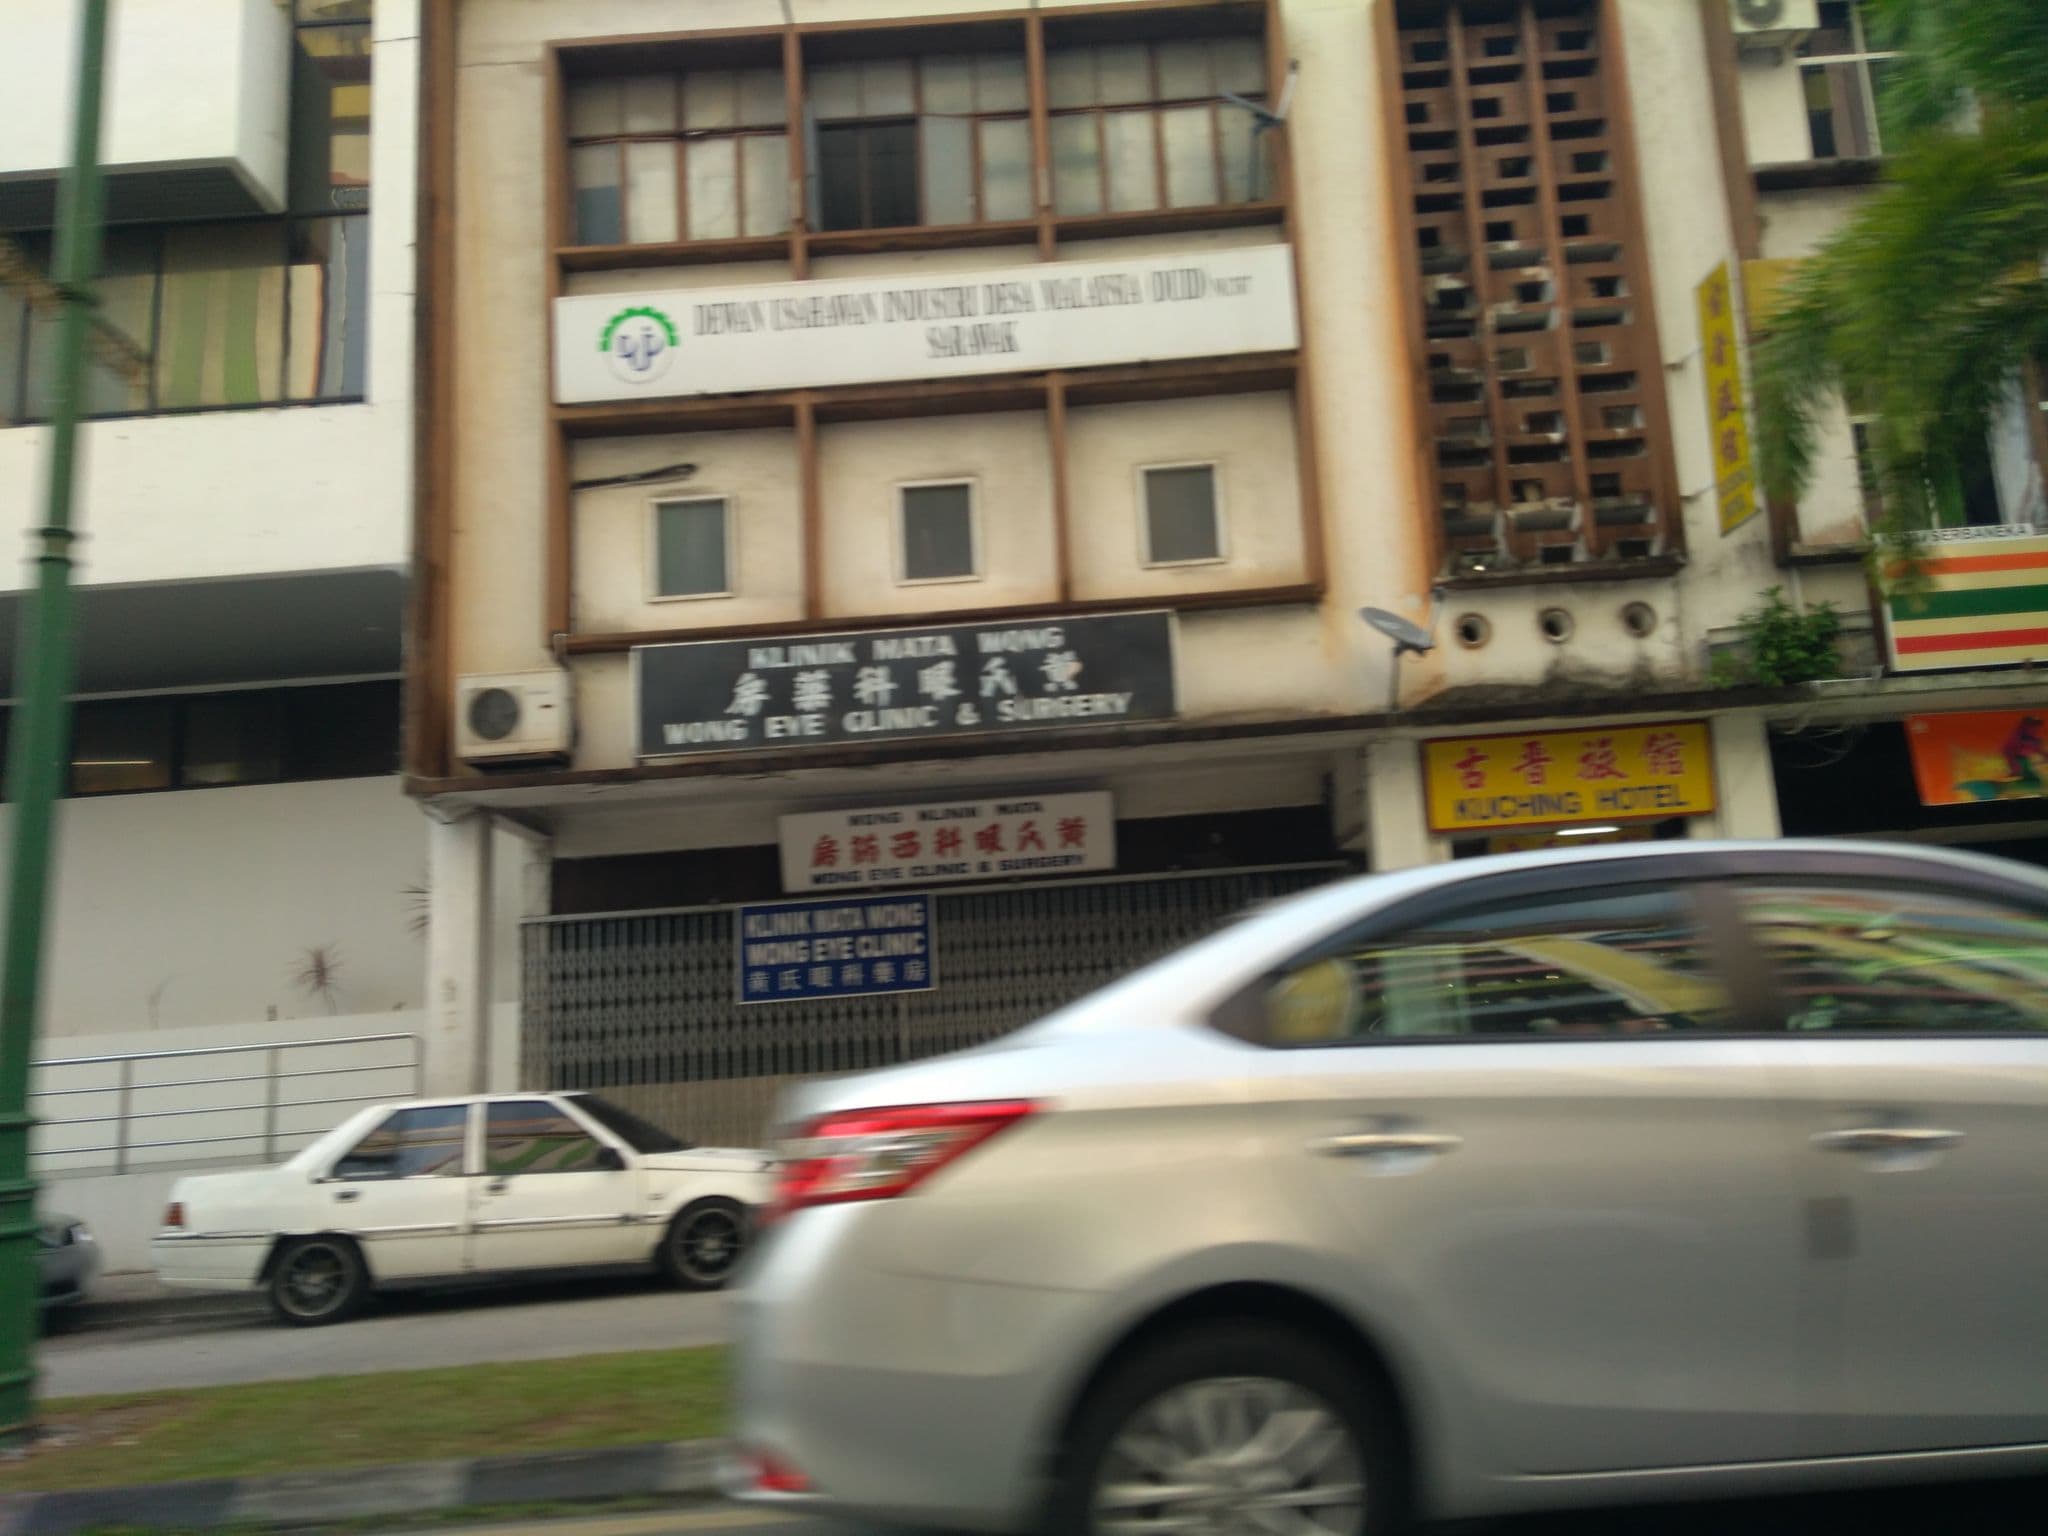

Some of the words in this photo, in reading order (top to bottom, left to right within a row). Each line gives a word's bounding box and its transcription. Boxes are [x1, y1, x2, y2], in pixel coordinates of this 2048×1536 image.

[748, 641, 857, 669] KLINIK
[872, 635, 957, 661] MATA
[976, 627, 1066, 654] WONG
[662, 719, 749, 745] WONG
[764, 713, 827, 738] EYE
[842, 705, 939, 733] CLINIC
[955, 702, 982, 726] &
[997, 691, 1134, 722] SURGERY
[847, 811, 903, 827] WONG
[917, 806, 979, 822] KLINIK
[995, 801, 1044, 816] MATA
[1455, 789, 1584, 821] KUCHING
[1595, 783, 1691, 811] HOTEL
[811, 869, 861, 885] WONG
[868, 867, 903, 881] EYE
[909, 861, 970, 878] CLINIC
[998, 853, 1087, 872] SURGERY
[744, 910, 811, 939] KLINIK
[812, 906, 866, 933] MATA
[866, 902, 926, 929] WONG
[745, 939, 811, 967] WONG
[812, 935, 856, 963] EYE
[856, 931, 927, 959] CLINIC
